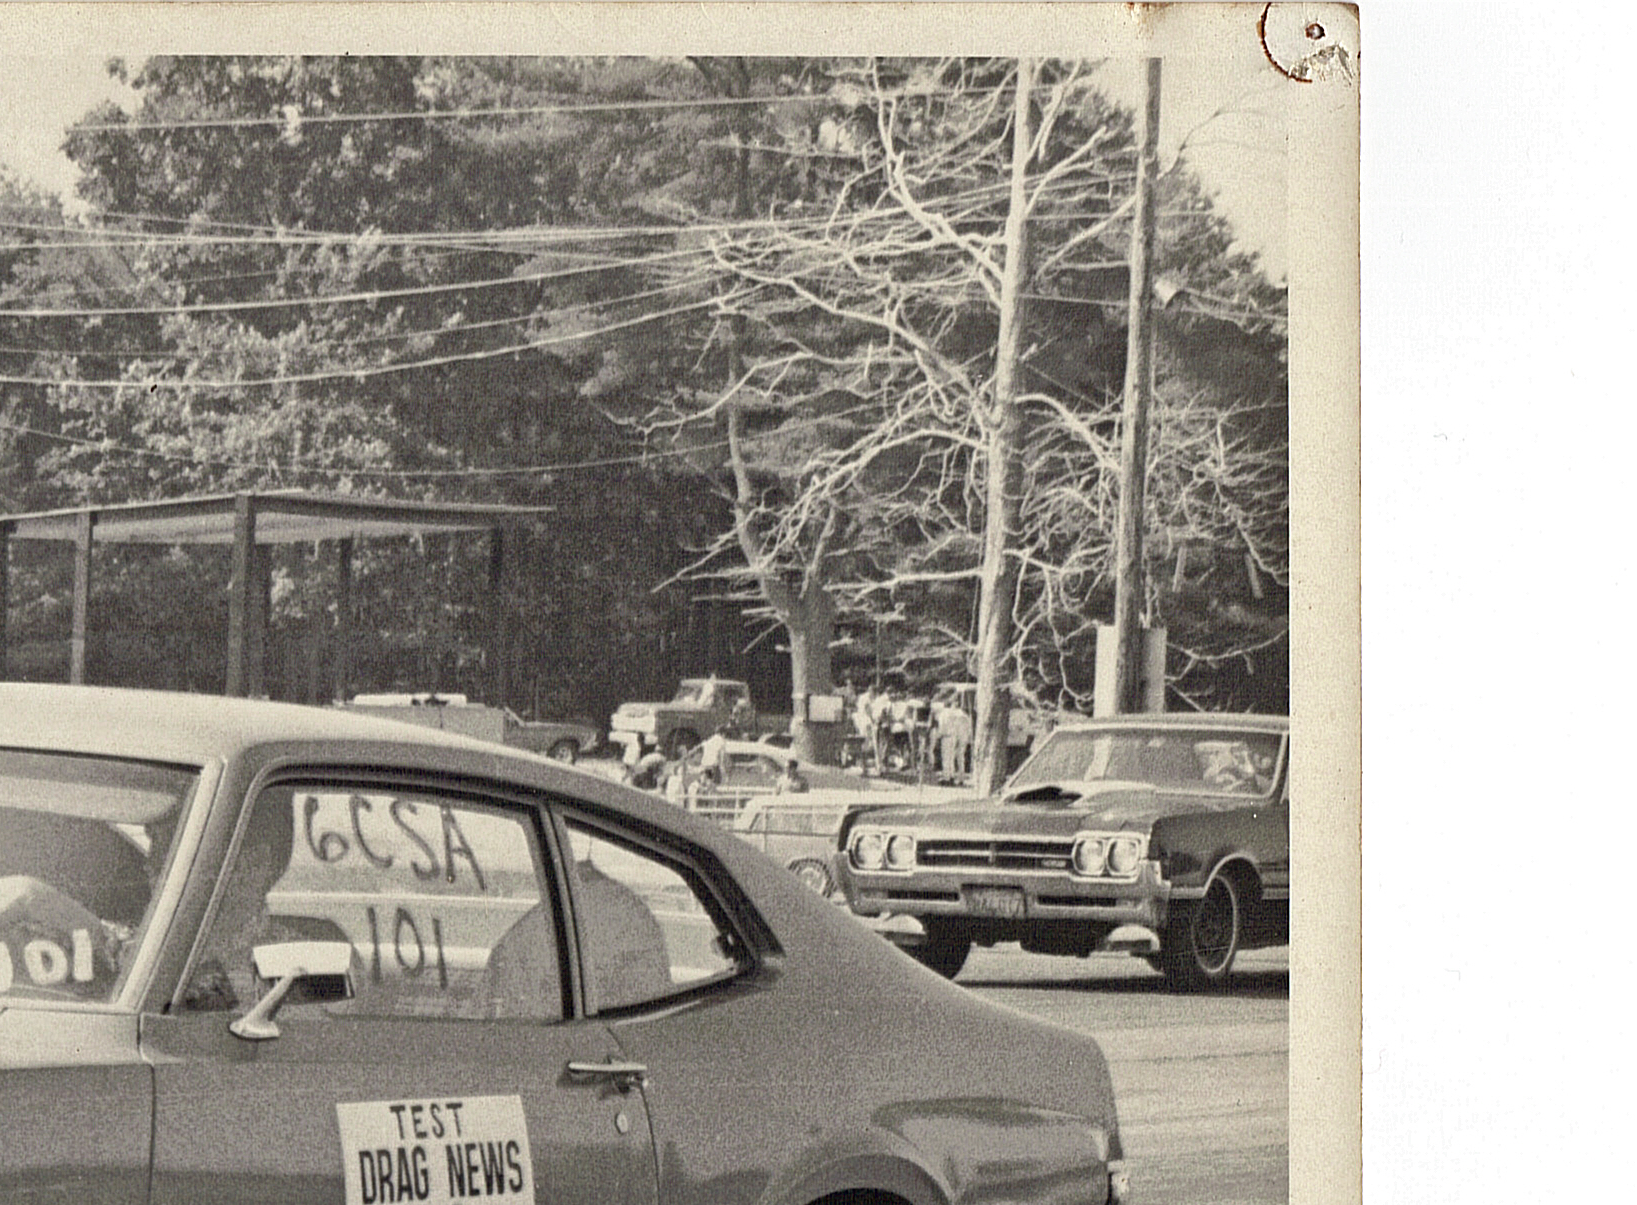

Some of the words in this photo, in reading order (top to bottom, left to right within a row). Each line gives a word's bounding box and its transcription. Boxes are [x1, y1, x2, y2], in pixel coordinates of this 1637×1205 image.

[366, 904, 450, 991] 101
[389, 1102, 463, 1140] TEST
[358, 1144, 430, 1205] DRAG
[445, 1139, 524, 1199] NEWS
